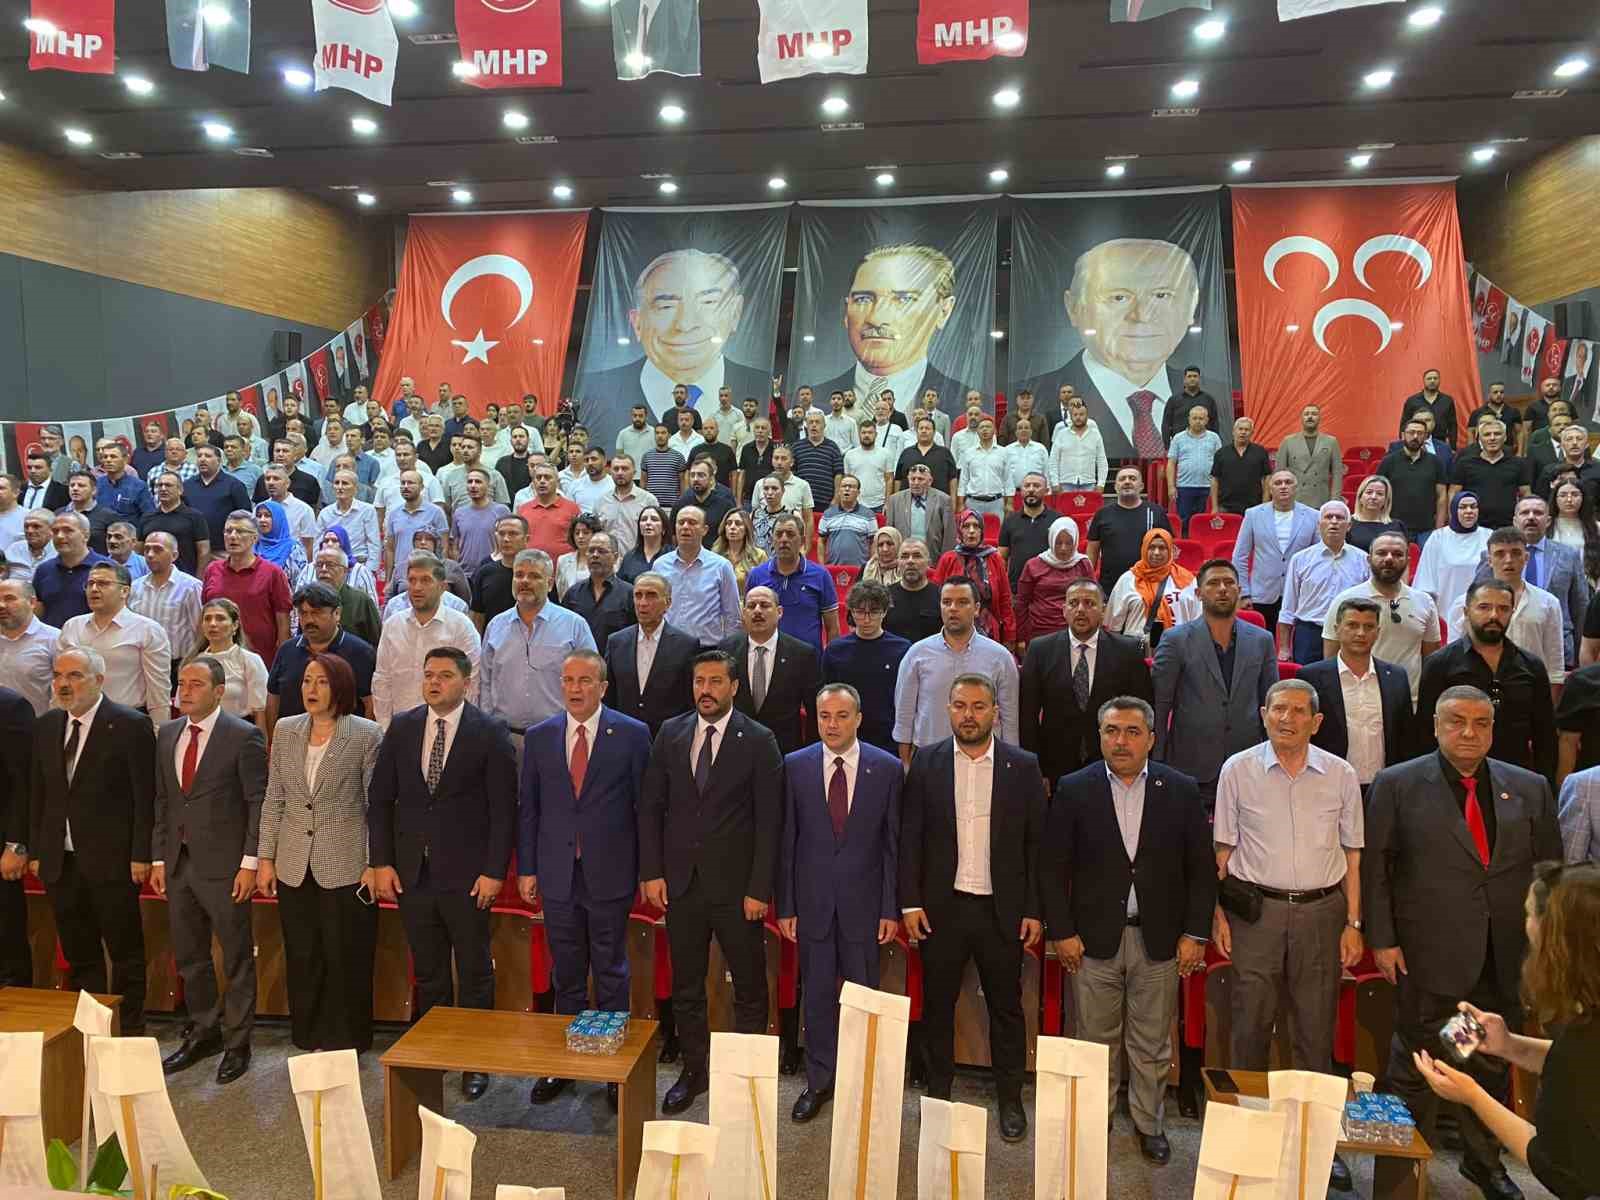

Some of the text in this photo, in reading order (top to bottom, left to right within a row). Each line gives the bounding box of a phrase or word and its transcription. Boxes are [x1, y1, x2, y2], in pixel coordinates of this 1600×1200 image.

[36, 30, 102, 58] MHP
[935, 16, 1013, 48] MHP
[322, 43, 383, 78] MHP
[473, 49, 547, 74] MHP
